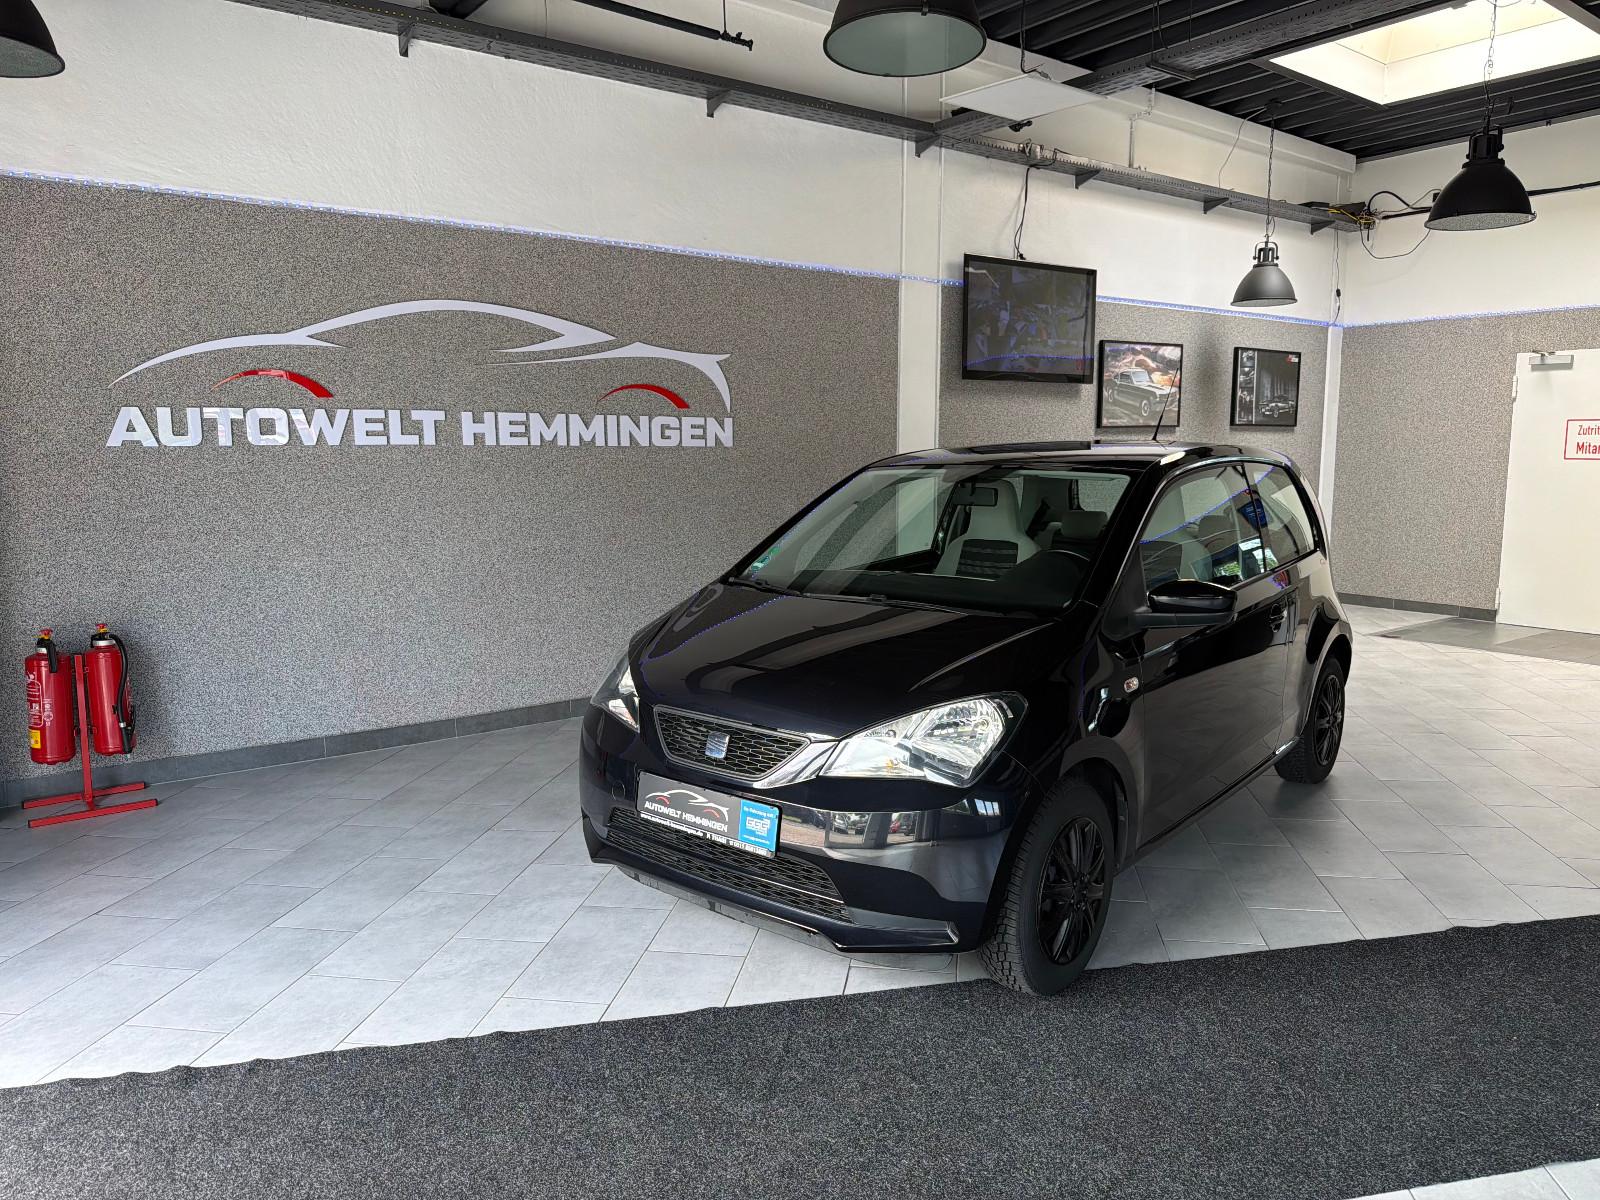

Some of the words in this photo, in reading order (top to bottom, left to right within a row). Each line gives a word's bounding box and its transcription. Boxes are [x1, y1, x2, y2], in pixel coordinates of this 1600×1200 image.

[106, 406, 447, 448] AUTOWELT
[460, 411, 735, 448] HEMMINGEN
[644, 801, 681, 818] AUTOWELT
[682, 811, 729, 833] HEMMINGEN
